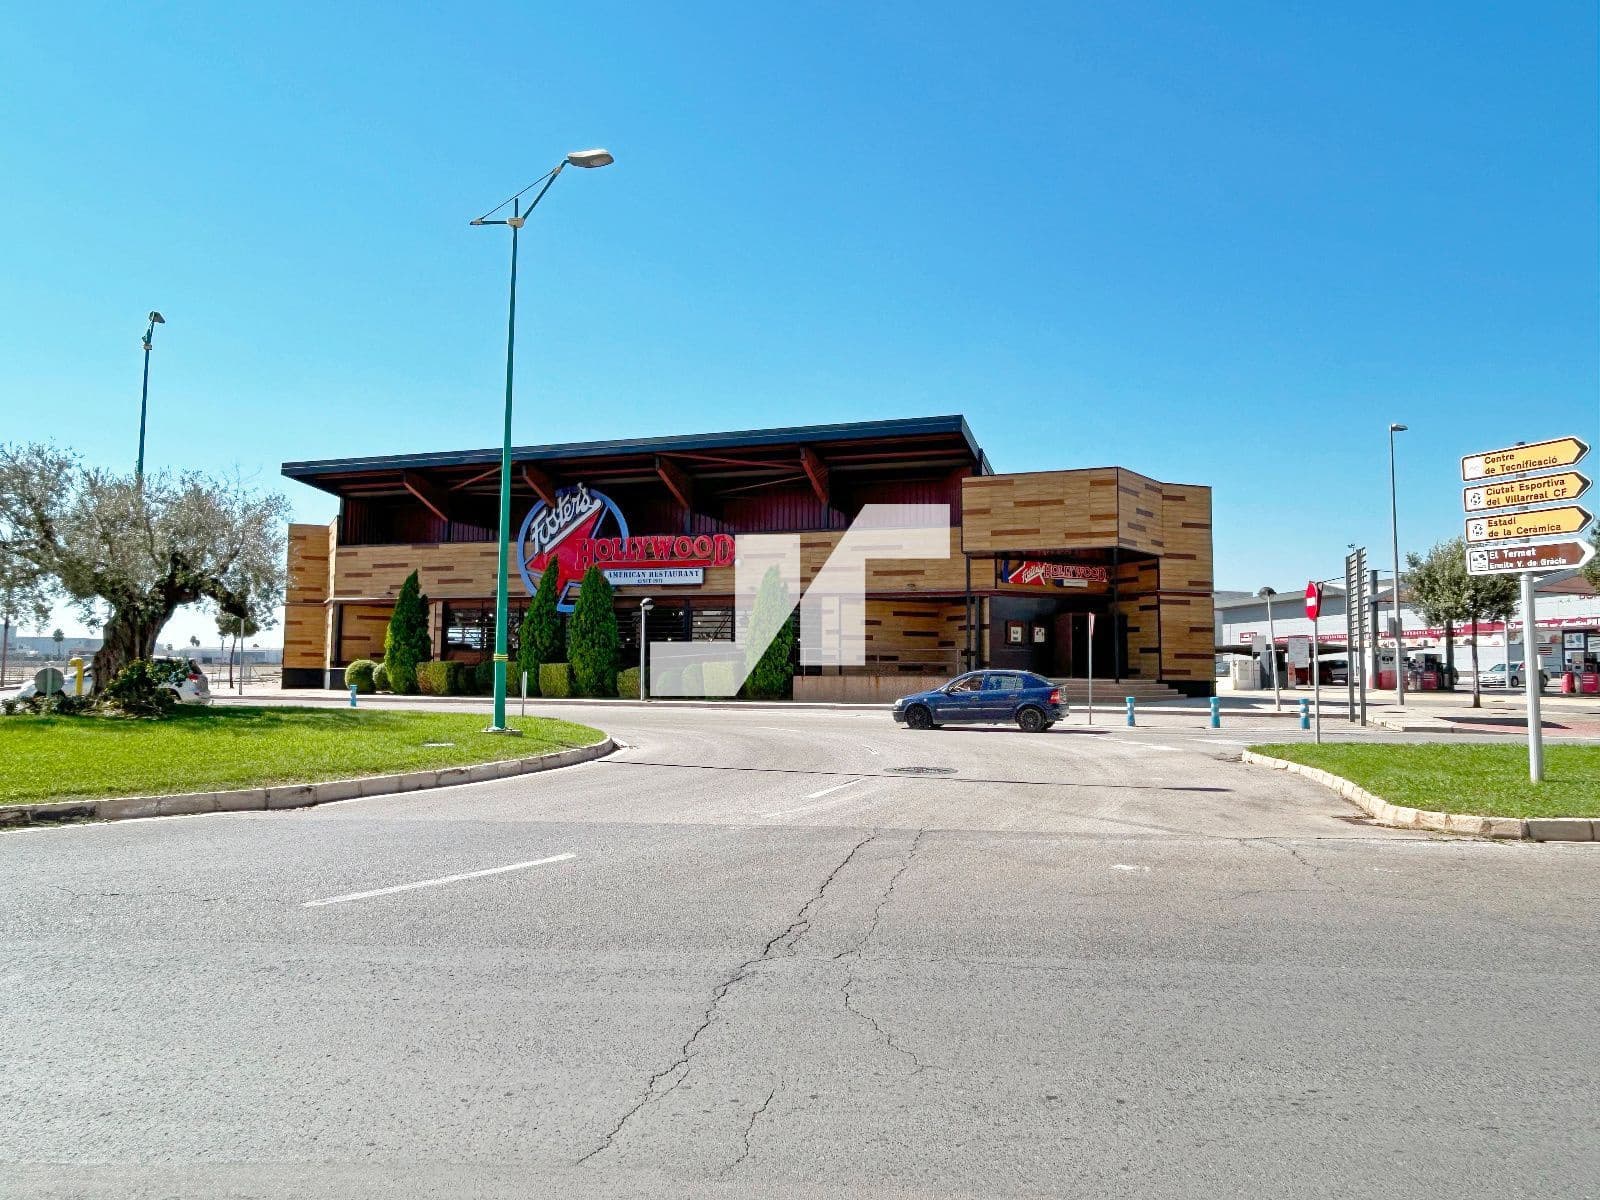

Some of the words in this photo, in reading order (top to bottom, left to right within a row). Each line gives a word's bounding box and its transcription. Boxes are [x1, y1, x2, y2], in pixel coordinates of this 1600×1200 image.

[1485, 454, 1514, 463] Centre
[1485, 467, 1496, 475] de
[1501, 457, 1557, 472] Tecnificació
[1486, 485, 1515, 496] Ciutat
[1519, 479, 1566, 491] Esportiva
[1486, 498, 1501, 506] del
[1506, 492, 1548, 503] Villarreal
[1553, 488, 1568, 497] CF
[1487, 517, 1516, 527] Estadi
[574, 534, 736, 570] HOLLYWOOD
[1489, 551, 1499, 559] El
[608, 571, 646, 579] AMERICAN
[648, 569, 700, 578] RESTAURANT
